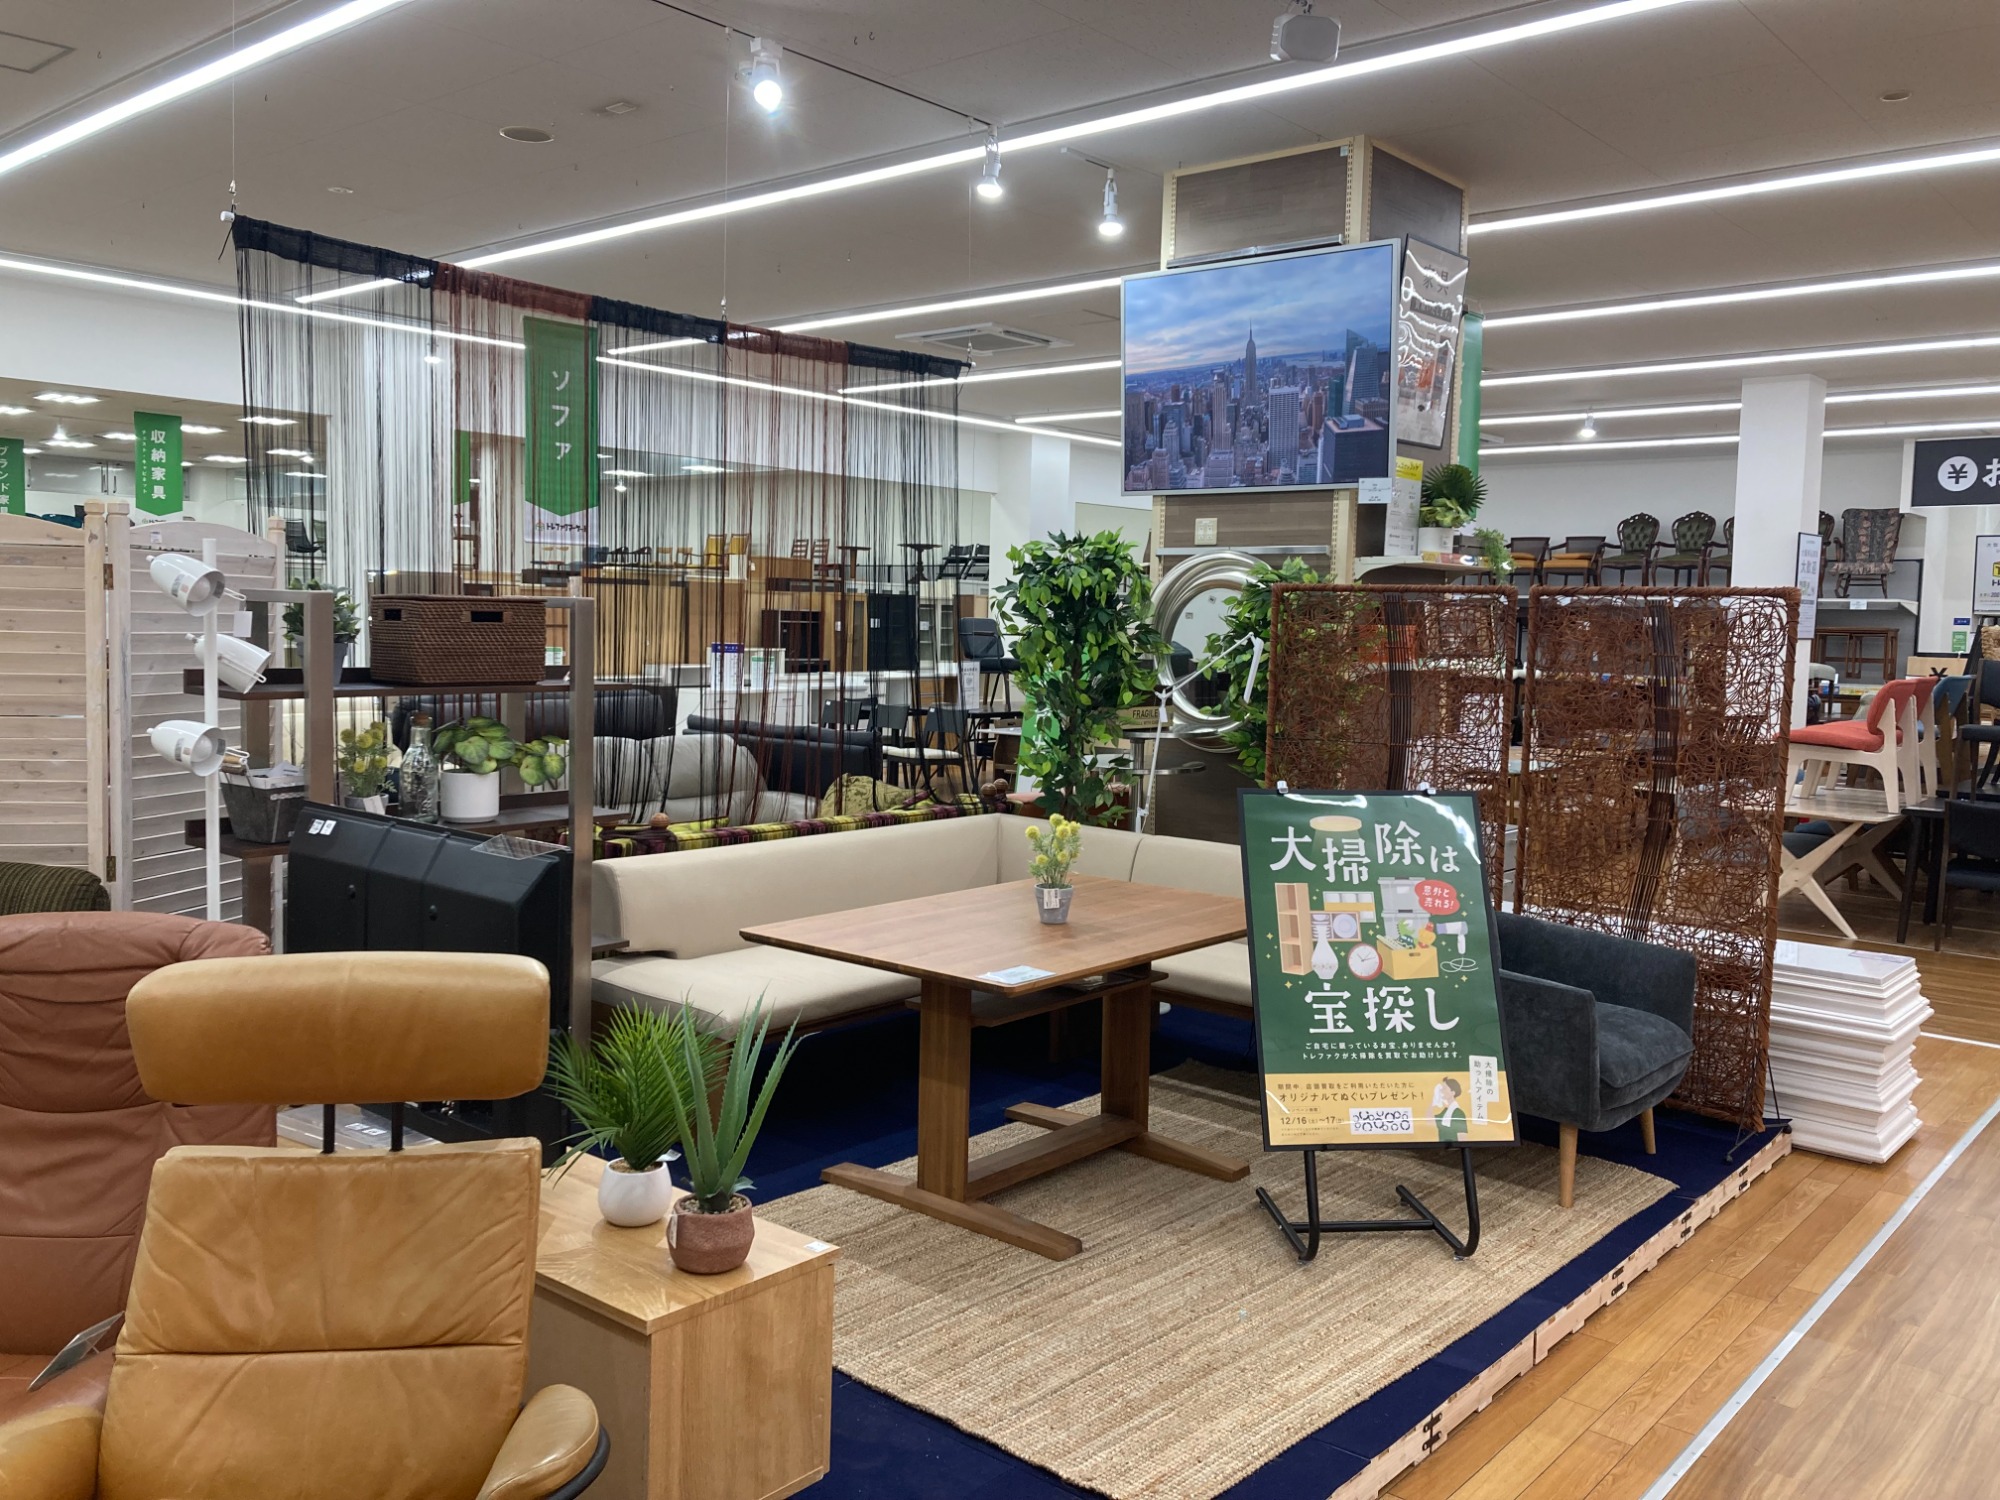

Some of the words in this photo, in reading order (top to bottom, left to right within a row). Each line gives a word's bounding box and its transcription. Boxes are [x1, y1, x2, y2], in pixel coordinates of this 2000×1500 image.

[551, 370, 572, 460] ソファ
[150, 429, 167, 500] 収納家具
[1132, 709, 1158, 719] FRAGILE
[1270, 820, 1461, 885] 大掃除は
[1422, 885, 1450, 898] 意外と
[1303, 982, 1461, 1035] 宝探し
